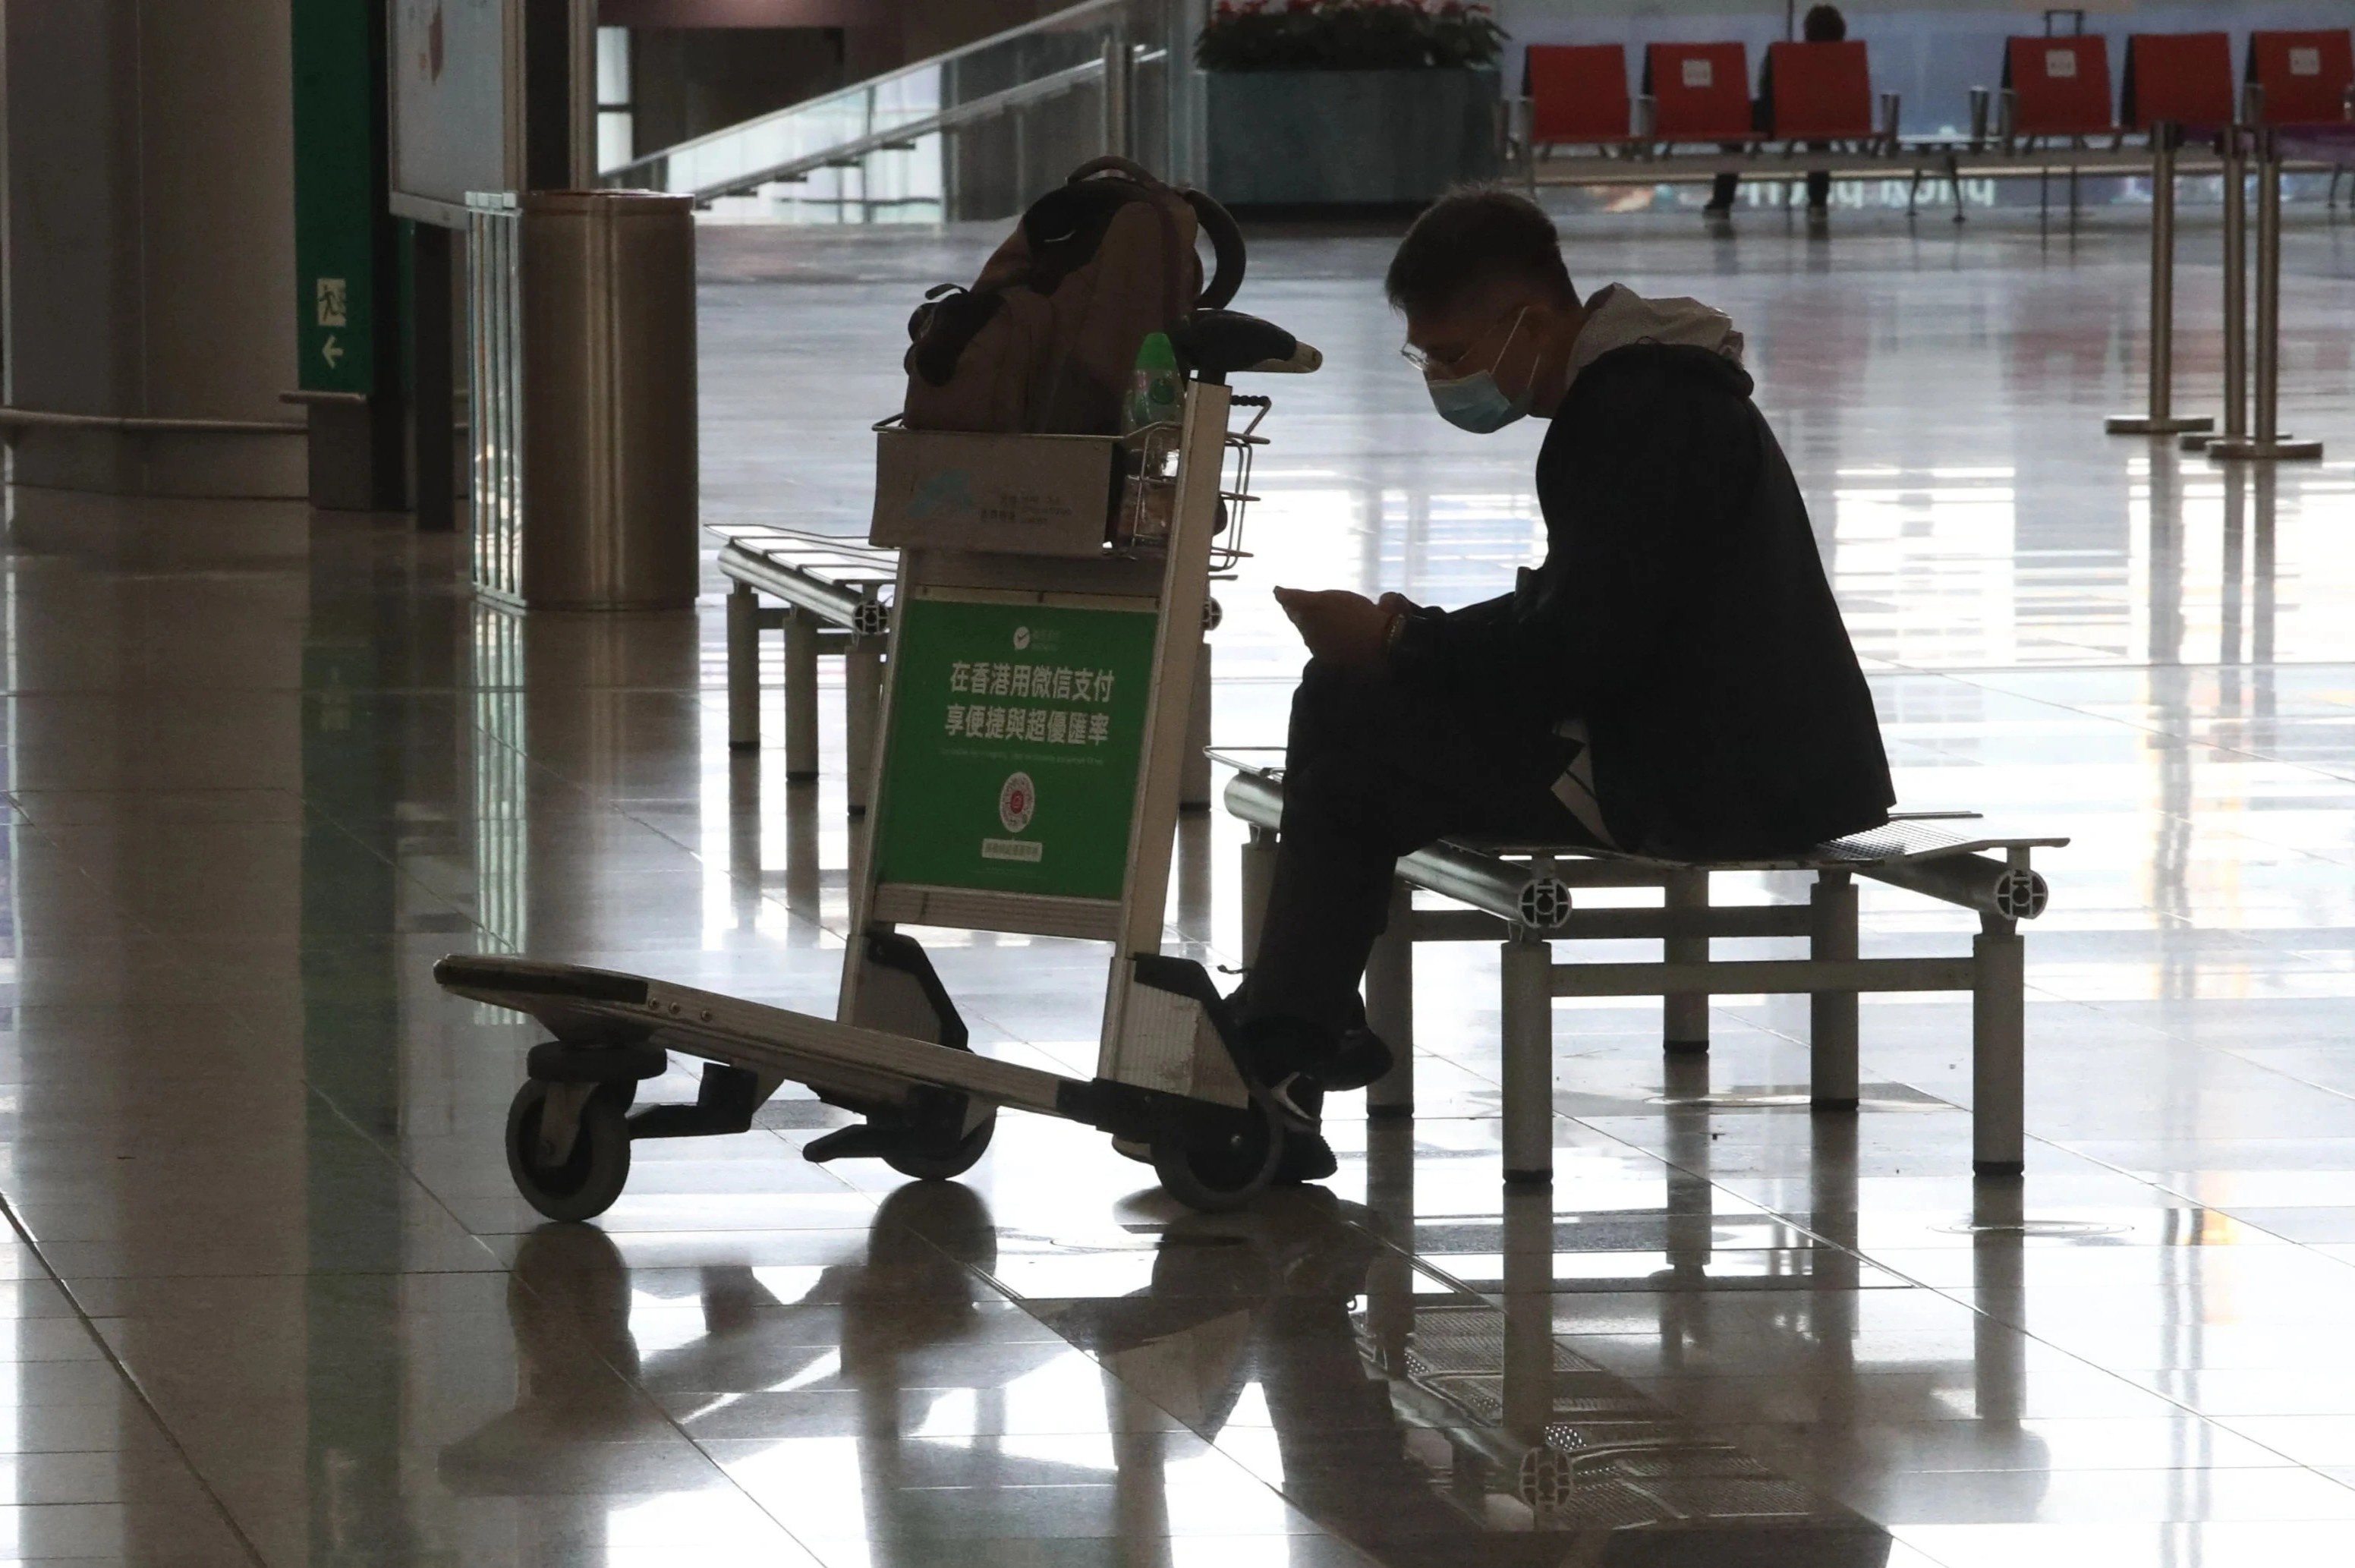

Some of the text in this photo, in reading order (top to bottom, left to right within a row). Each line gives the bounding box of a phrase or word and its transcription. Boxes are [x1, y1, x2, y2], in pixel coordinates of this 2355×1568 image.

[949, 660, 1115, 703] 在香港用微信支付
[944, 704, 1110, 746] 享便捷與超優匯率
